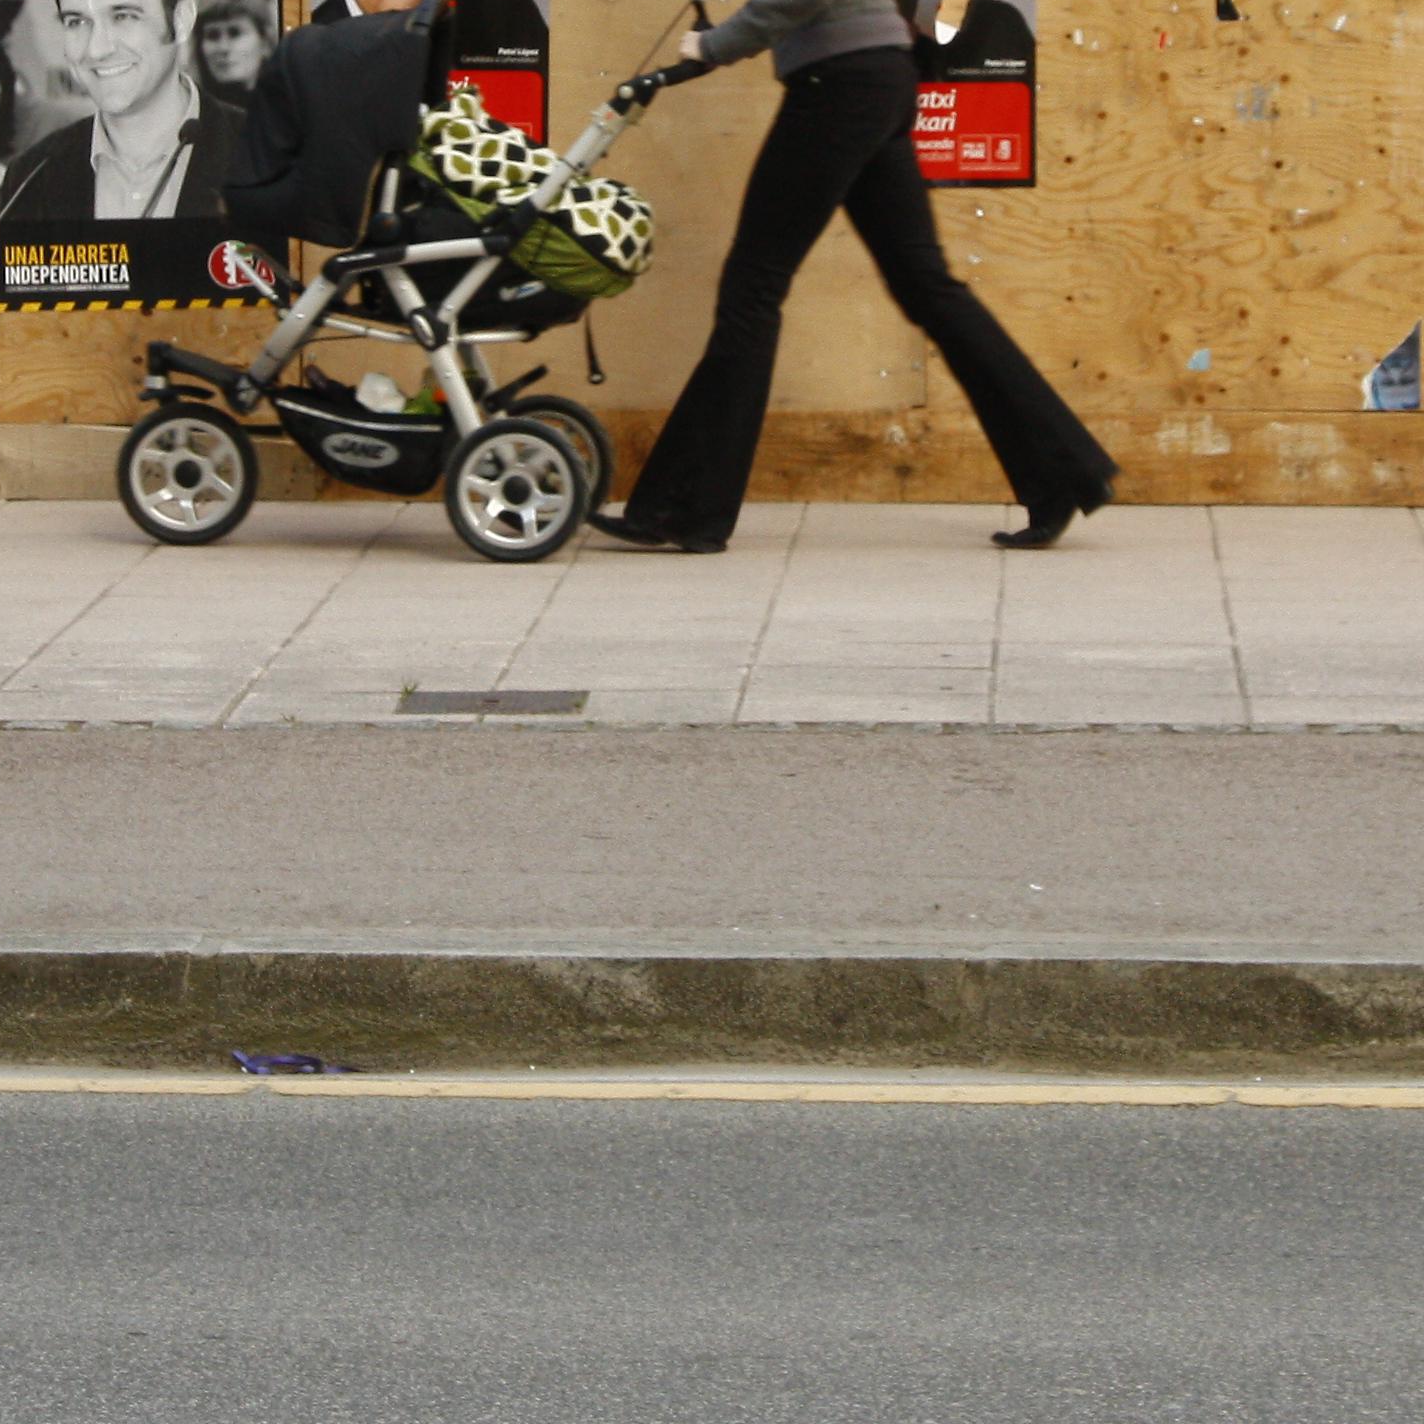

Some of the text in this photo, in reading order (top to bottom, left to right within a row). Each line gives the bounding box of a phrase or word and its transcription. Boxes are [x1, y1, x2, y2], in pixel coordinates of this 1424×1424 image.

[917, 87, 958, 110] atxi
[4, 243, 130, 266] UNAI ZIARRETA
[4, 264, 130, 285] INDEPENDENTEA
